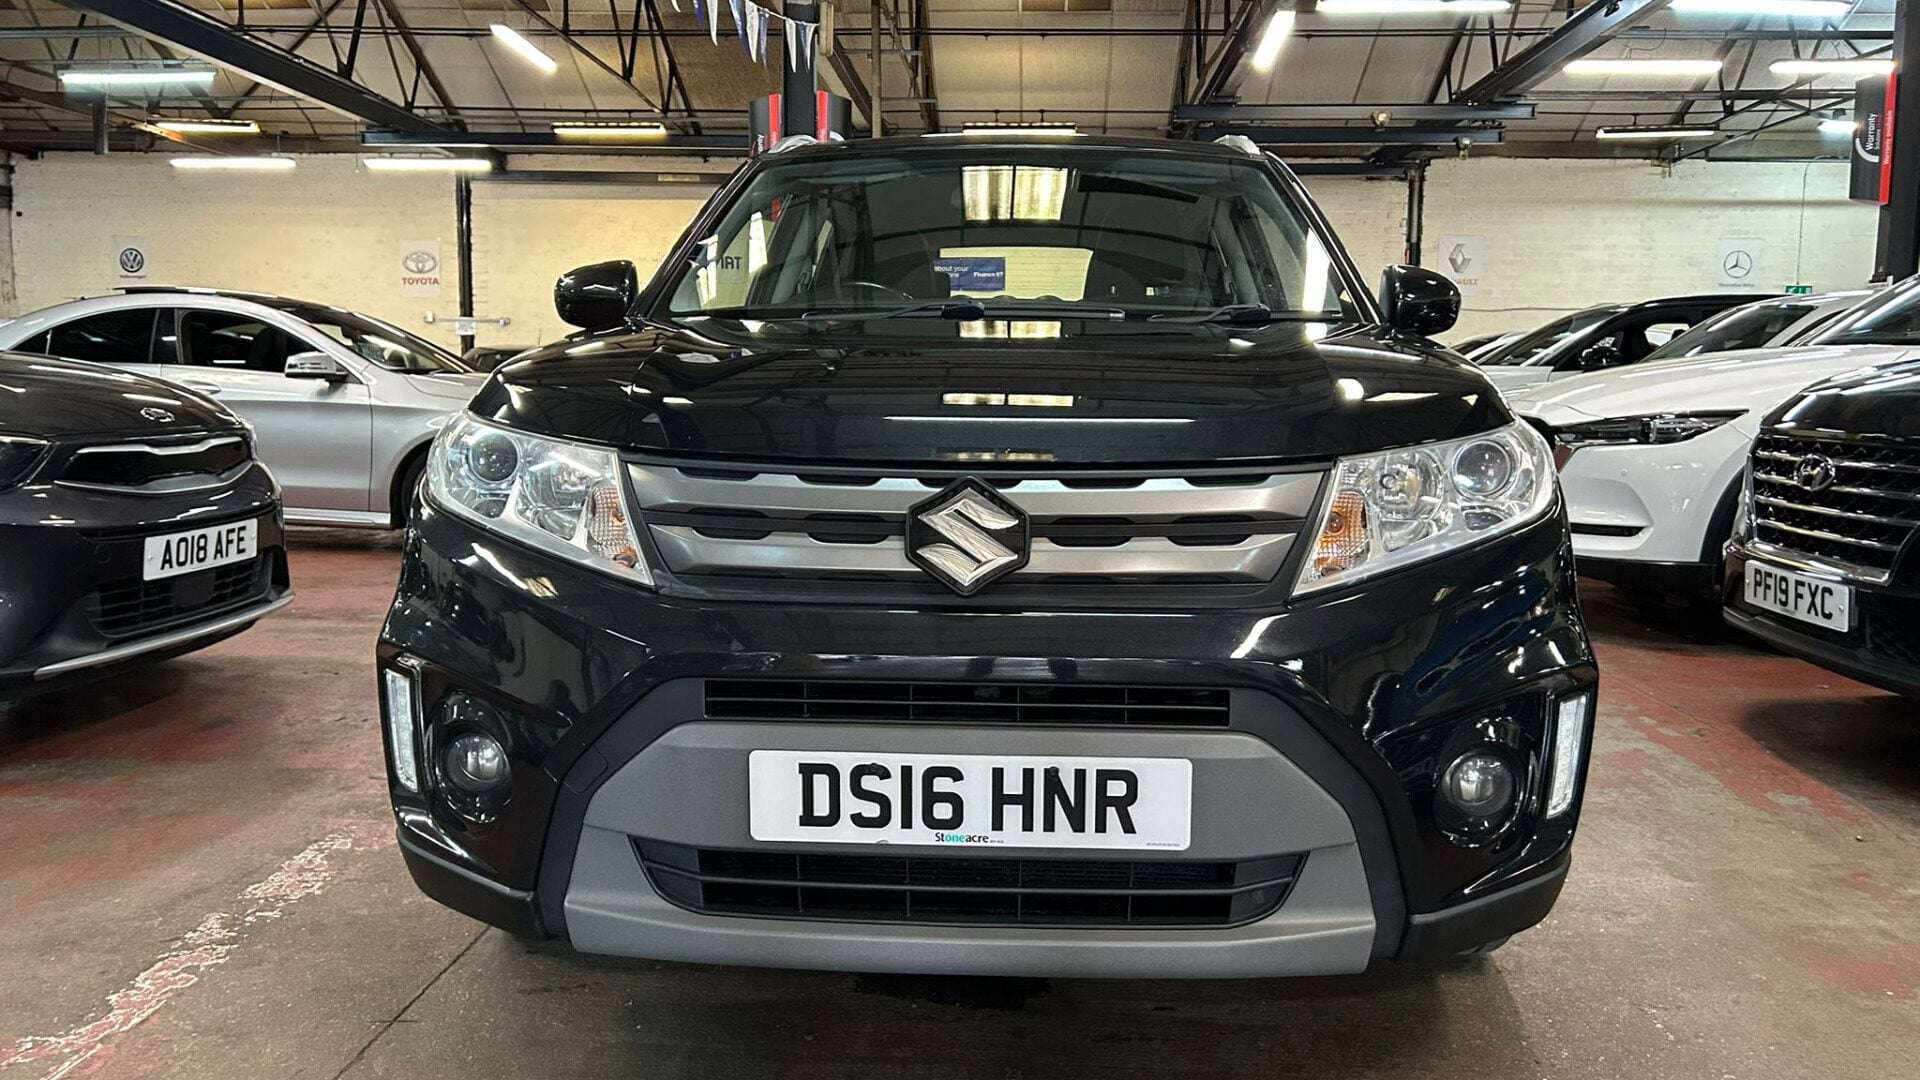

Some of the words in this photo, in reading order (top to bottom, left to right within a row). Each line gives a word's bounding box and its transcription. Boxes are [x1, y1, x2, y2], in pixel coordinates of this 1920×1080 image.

[1865, 113, 1877, 151] Warranty
[402, 277, 440, 286] TOYOTA
[719, 256, 743, 269] IAT
[160, 533, 208, 571] AO18
[213, 525, 247, 560] AFE
[1753, 567, 1789, 608] PF19
[1794, 579, 1834, 620] FXC
[798, 762, 965, 832] DS16
[991, 766, 1139, 834] HNR
[935, 831, 990, 844] Stoneacre
